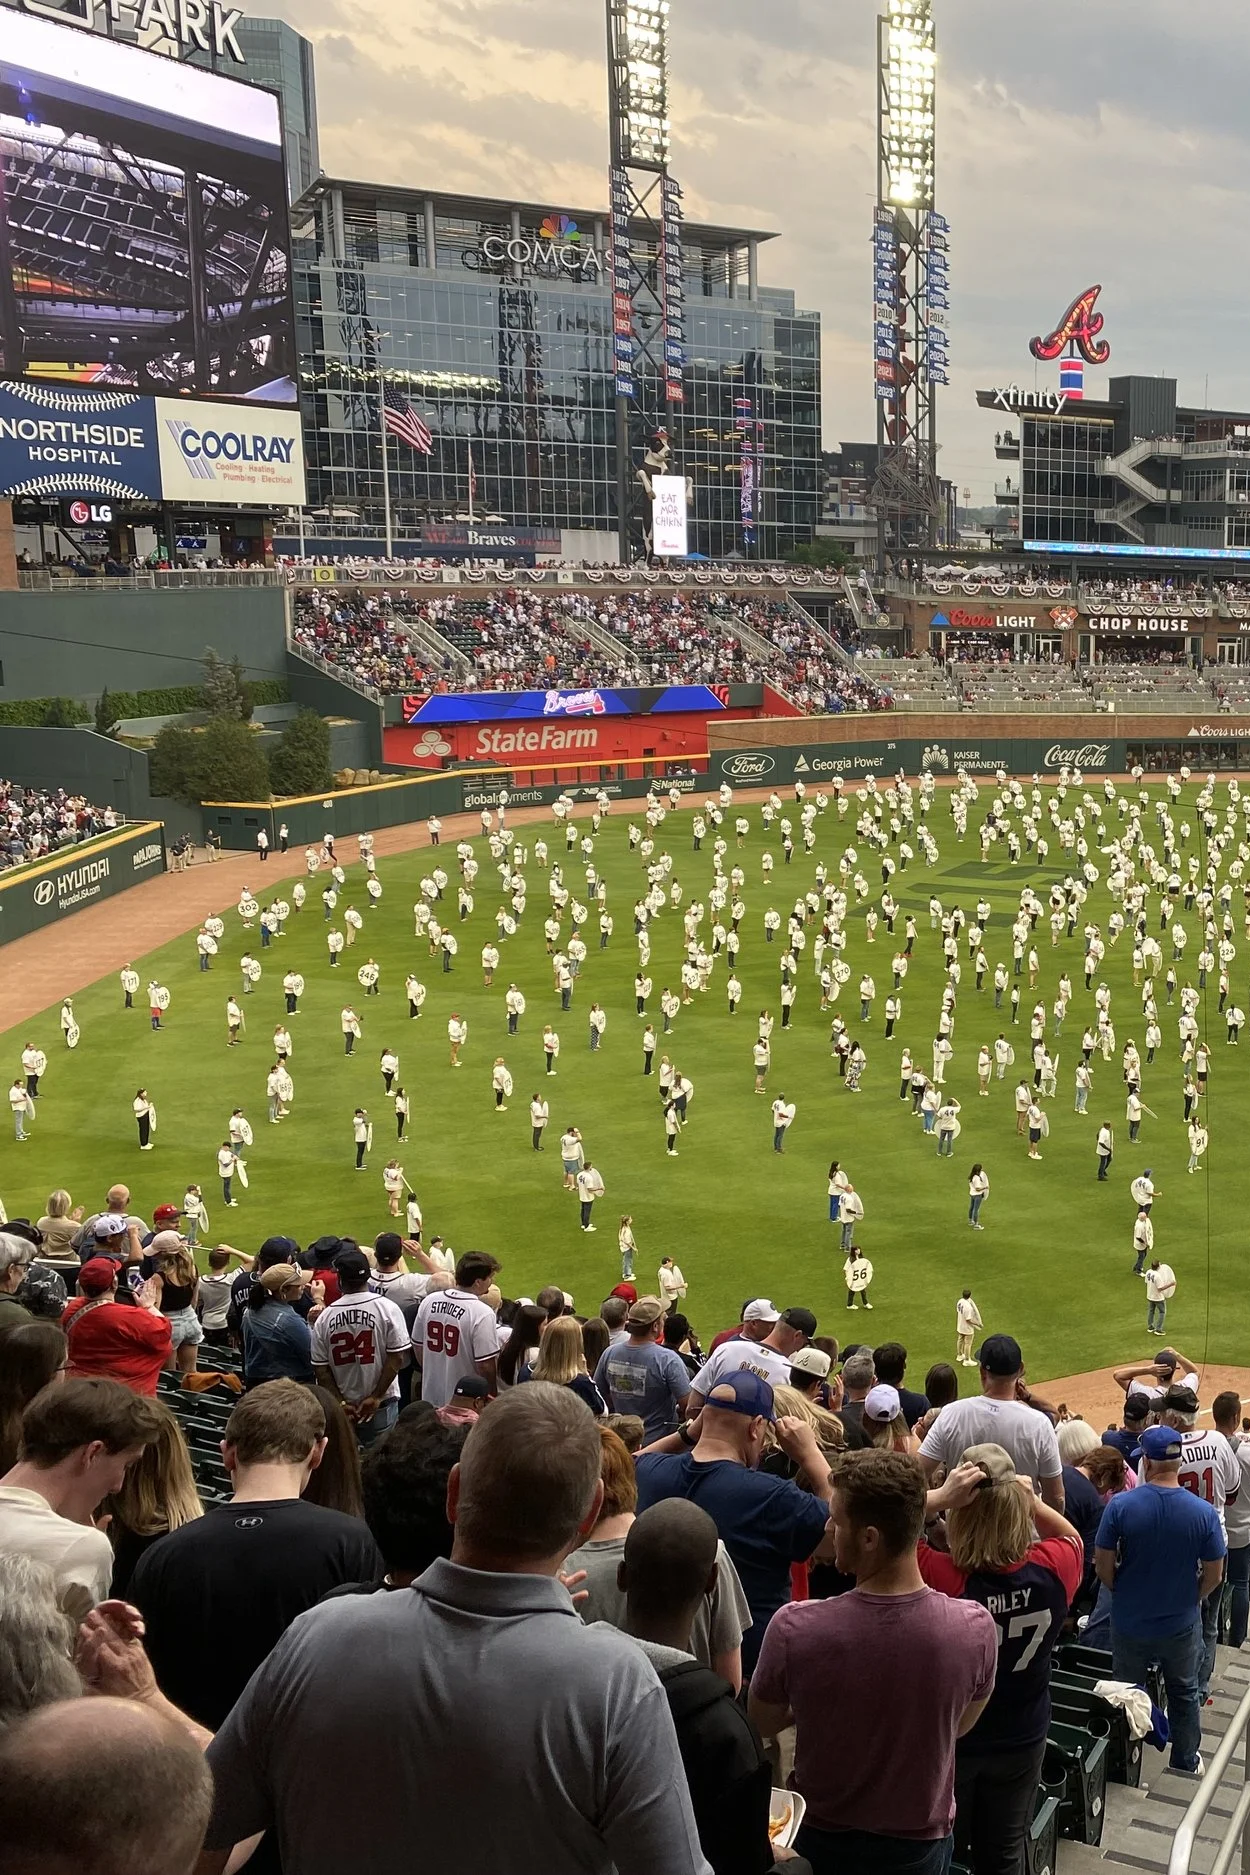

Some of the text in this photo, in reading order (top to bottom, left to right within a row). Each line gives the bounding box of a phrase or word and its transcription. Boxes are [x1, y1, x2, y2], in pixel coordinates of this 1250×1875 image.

[112, 0, 246, 64] PARK
[664, 200, 678, 215] 1875
[877, 210, 893, 223] 1996
[484, 235, 614, 272] COMCAS
[877, 308, 892, 319] 2010
[930, 312, 944, 324] 2012
[877, 365, 893, 377] 2021
[930, 369, 944, 380] 2022
[877, 385, 893, 398] 2023
[993, 383, 1068, 414] xfinity
[0, 417, 145, 448] NORTHSIDE
[181, 428, 295, 463] COOLRAY
[29, 446, 121, 465] HOSPITAL
[215, 463, 275, 474] Cooling Heating
[223, 473, 292, 484] Plumbing Electrical
[661, 494, 677, 503] EAT
[91, 505, 112, 522] LG
[660, 504, 678, 515] MOR
[656, 517, 683, 527] CHIKIN
[467, 530, 516, 546] Braves
[949, 609, 1036, 628] Coors LIGHT
[1089, 618, 1189, 632] CHOP HOUSE
[1200, 725, 1228, 737] Coors
[953, 751, 980, 760] KAISER
[1044, 744, 1111, 767] Coca-Cola
[731, 756, 766, 774] Ford
[812, 756, 885, 771] Georgia Power
[953, 760, 1006, 769] PERMANENTE
[464, 790, 543, 808] globalpyments
[57, 858, 110, 896] HYUNDAI
[240, 903, 257, 912] 302
[360, 970, 375, 980] 246
[835, 968, 849, 977] 270
[1195, 1137, 1205, 1148] 91
[852, 1268, 867, 1281] 56
[430, 1301, 465, 1321] STRIDER
[328, 1309, 376, 1334] SANDERS
[426, 1320, 460, 1358] 99
[330, 1329, 375, 1366] 24
[1181, 1446, 1217, 1463] ADDUX
[987, 1588, 1031, 1614] RILEY
